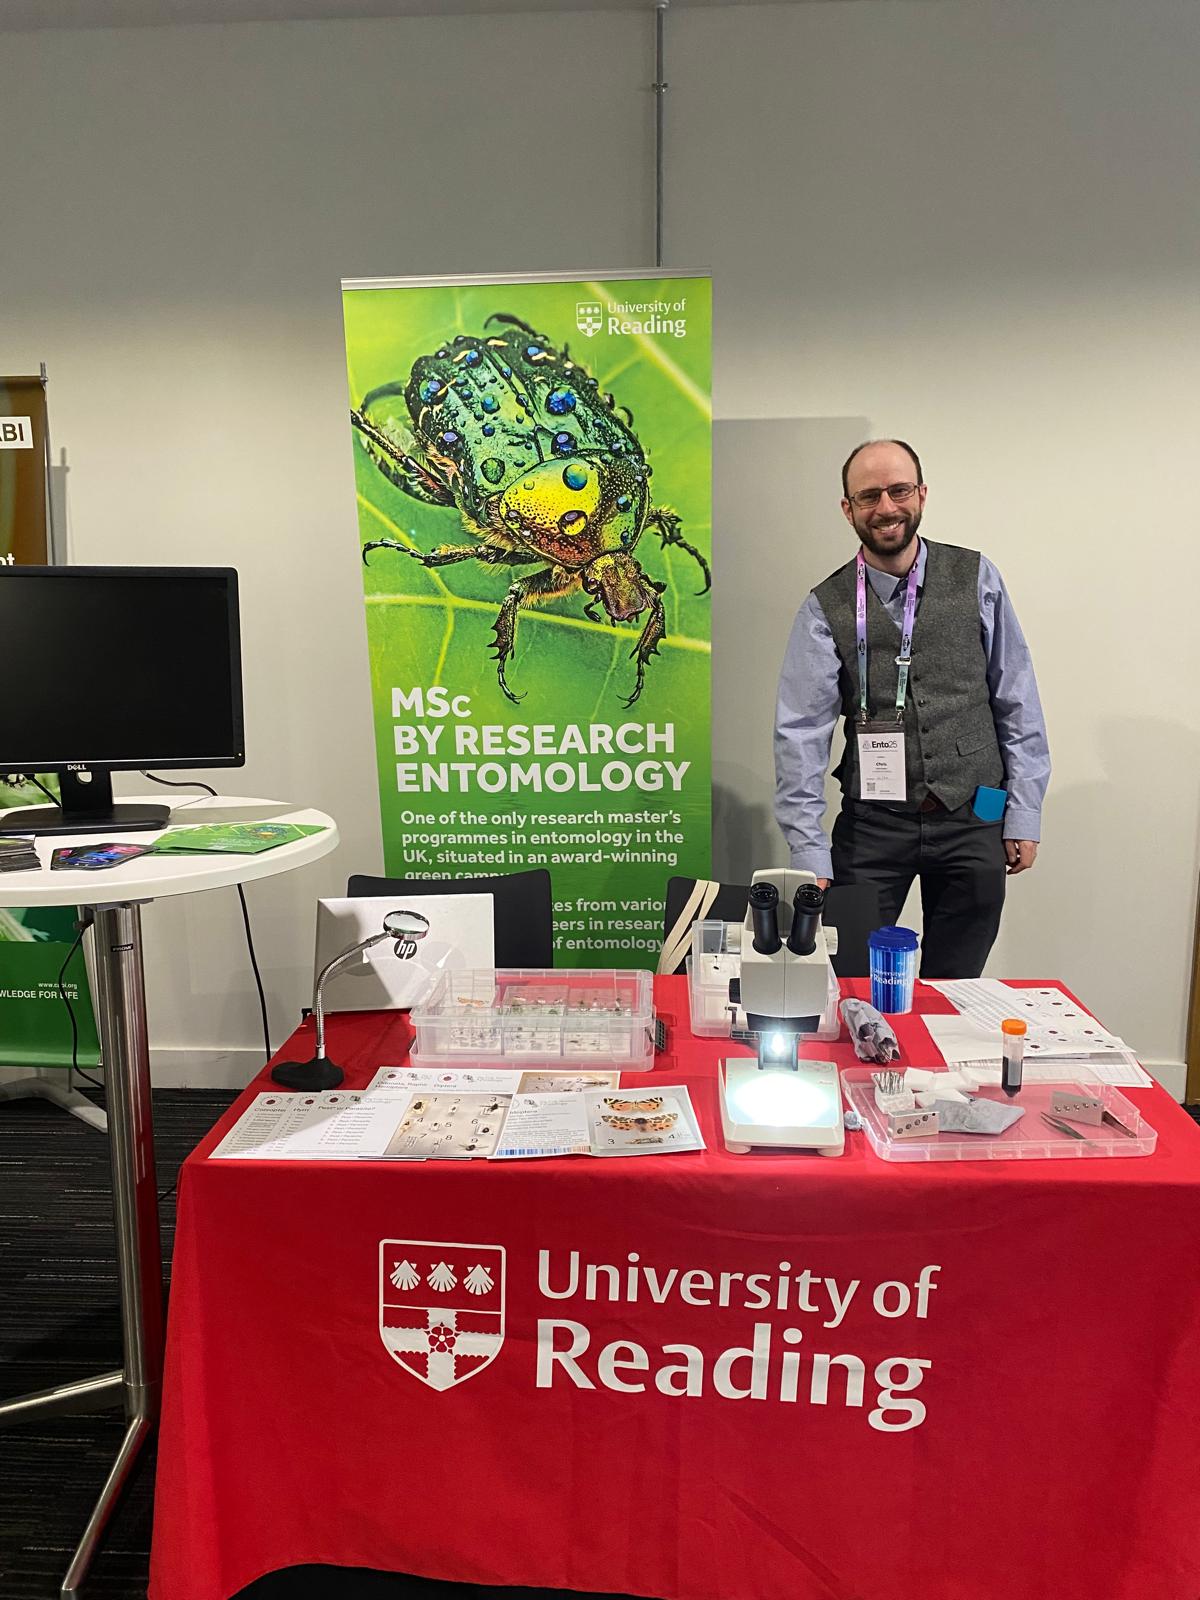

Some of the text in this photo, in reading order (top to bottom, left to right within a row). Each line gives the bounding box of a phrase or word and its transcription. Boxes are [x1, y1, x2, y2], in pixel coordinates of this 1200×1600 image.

[607, 298, 687, 315] University of
[608, 314, 687, 337] Reading
[0, 423, 24, 441] BI
[391, 687, 472, 718] MSc
[394, 722, 675, 756] BY RESEARCH
[396, 760, 691, 793] ENTOMOLOGY
[401, 811, 435, 824] One
[439, 811, 457, 824] of
[460, 811, 487, 824] the
[491, 811, 527, 828] only
[531, 810, 604, 824] research
[402, 829, 684, 847] programmes in entomology in the
[403, 849, 678, 866] UK, situated in an award-winning
[576, 898, 617, 911] from
[589, 917, 604, 930] in
[396, 940, 415, 960] hp
[39, 991, 57, 999] FOR
[538, 1249, 942, 1329] University of
[535, 1319, 932, 1432] Reading
